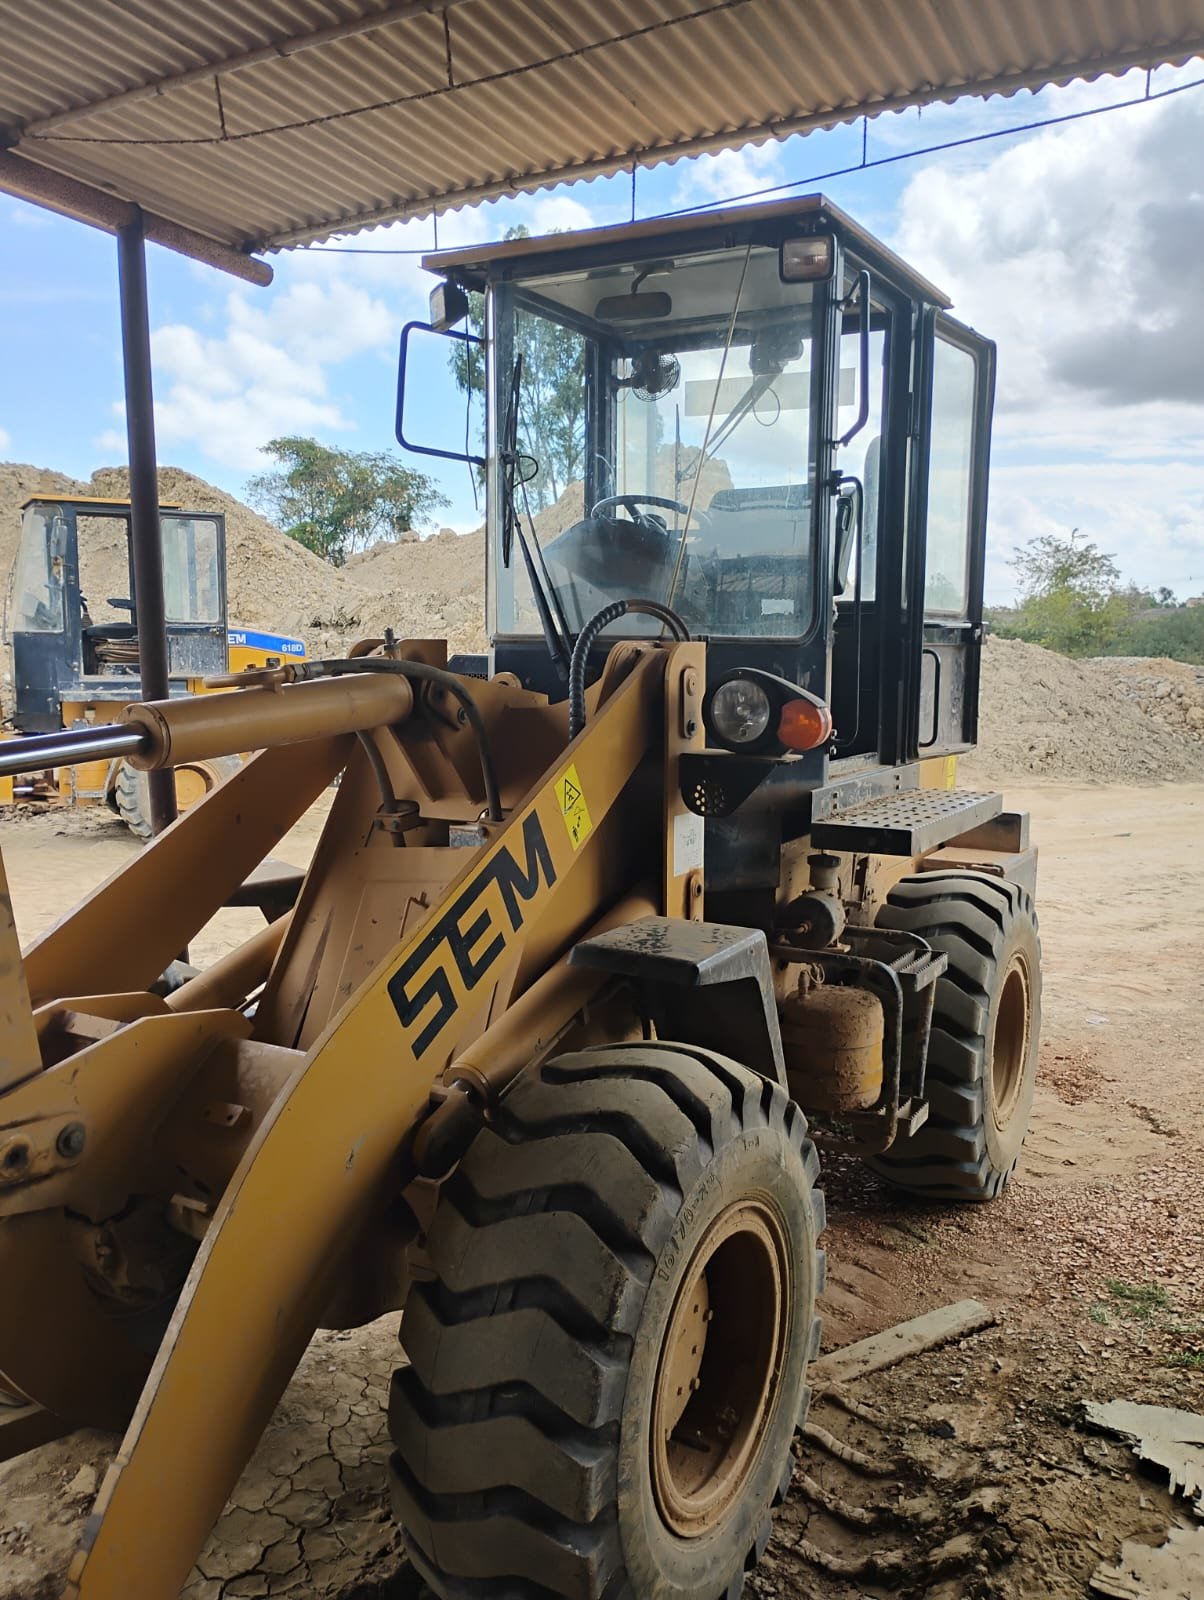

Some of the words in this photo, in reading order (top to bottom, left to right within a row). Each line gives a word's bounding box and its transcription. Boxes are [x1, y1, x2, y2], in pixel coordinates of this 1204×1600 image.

[228, 633, 247, 645] EM
[281, 643, 303, 652] 618D
[387, 808, 557, 1061] SEM
